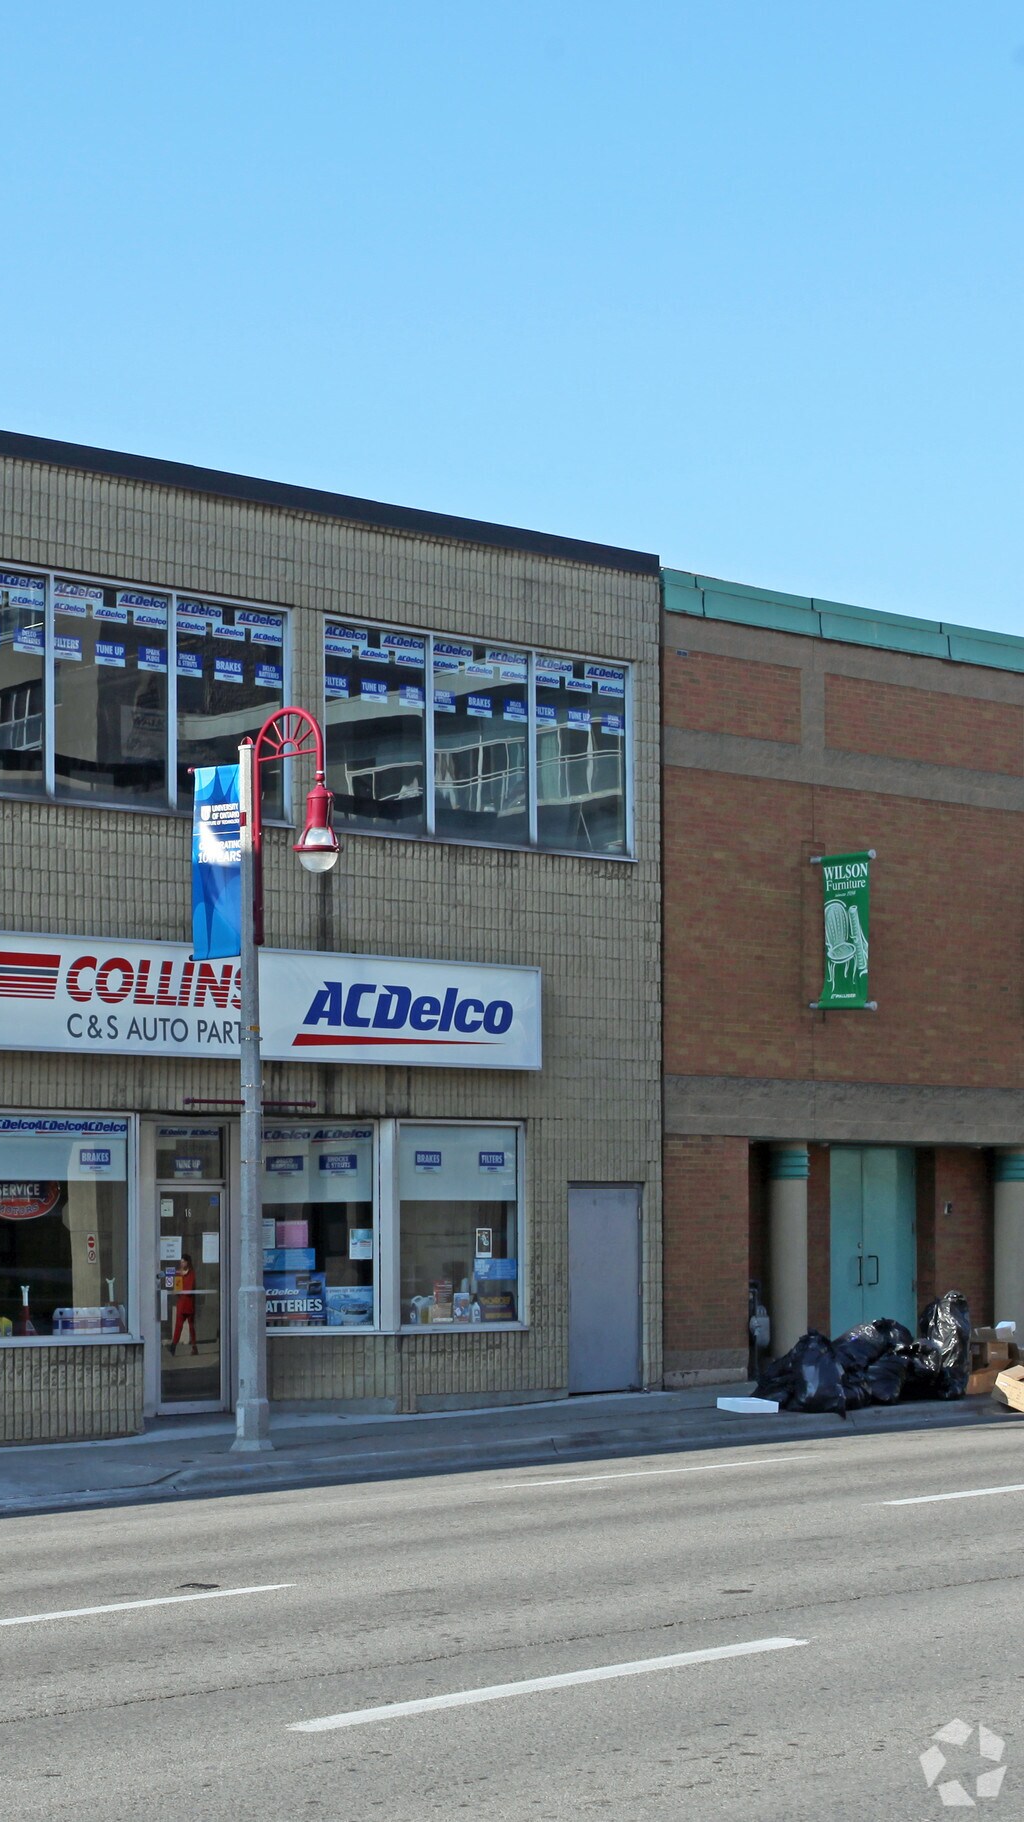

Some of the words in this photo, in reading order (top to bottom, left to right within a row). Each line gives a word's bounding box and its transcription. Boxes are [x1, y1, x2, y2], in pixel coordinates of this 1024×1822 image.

[54, 582, 102, 599] ACDelco
[120, 593, 167, 609] ACDelco
[177, 602, 222, 618] ACDelco
[238, 612, 282, 627] ACDelco
[325, 626, 367, 641] ACDelco
[383, 635, 424, 649] ACDelco
[96, 644, 113, 655] TUNE
[115, 645, 124, 656] UP
[433, 643, 472, 657] ACDelco
[489, 652, 527, 665] ACDelco
[216, 660, 242, 673] BRAKES
[587, 667, 624, 680] ACDelco
[325, 676, 346, 688] FILTERS
[362, 682, 377, 692] TUNE
[378, 683, 387, 693] UP
[468, 696, 491, 708] BRAKES
[824, 863, 868, 880] WILSON
[826, 879, 866, 892] Furniture
[303, 981, 513, 1034] ACDelco
[127, 1017, 189, 1043] AUTO
[197, 1019, 242, 1045] PART
[35, 1120, 81, 1131] ACDelco
[82, 1122, 127, 1132] ACDelco
[262, 1130, 311, 1140] CDelco
[81, 1152, 109, 1162] BRAKES
[416, 1154, 440, 1164] BRAKES
[481, 1155, 503, 1164] FILTERS
[266, 1288, 300, 1296] CDelco
[266, 1299, 323, 1312] ATTERIES
